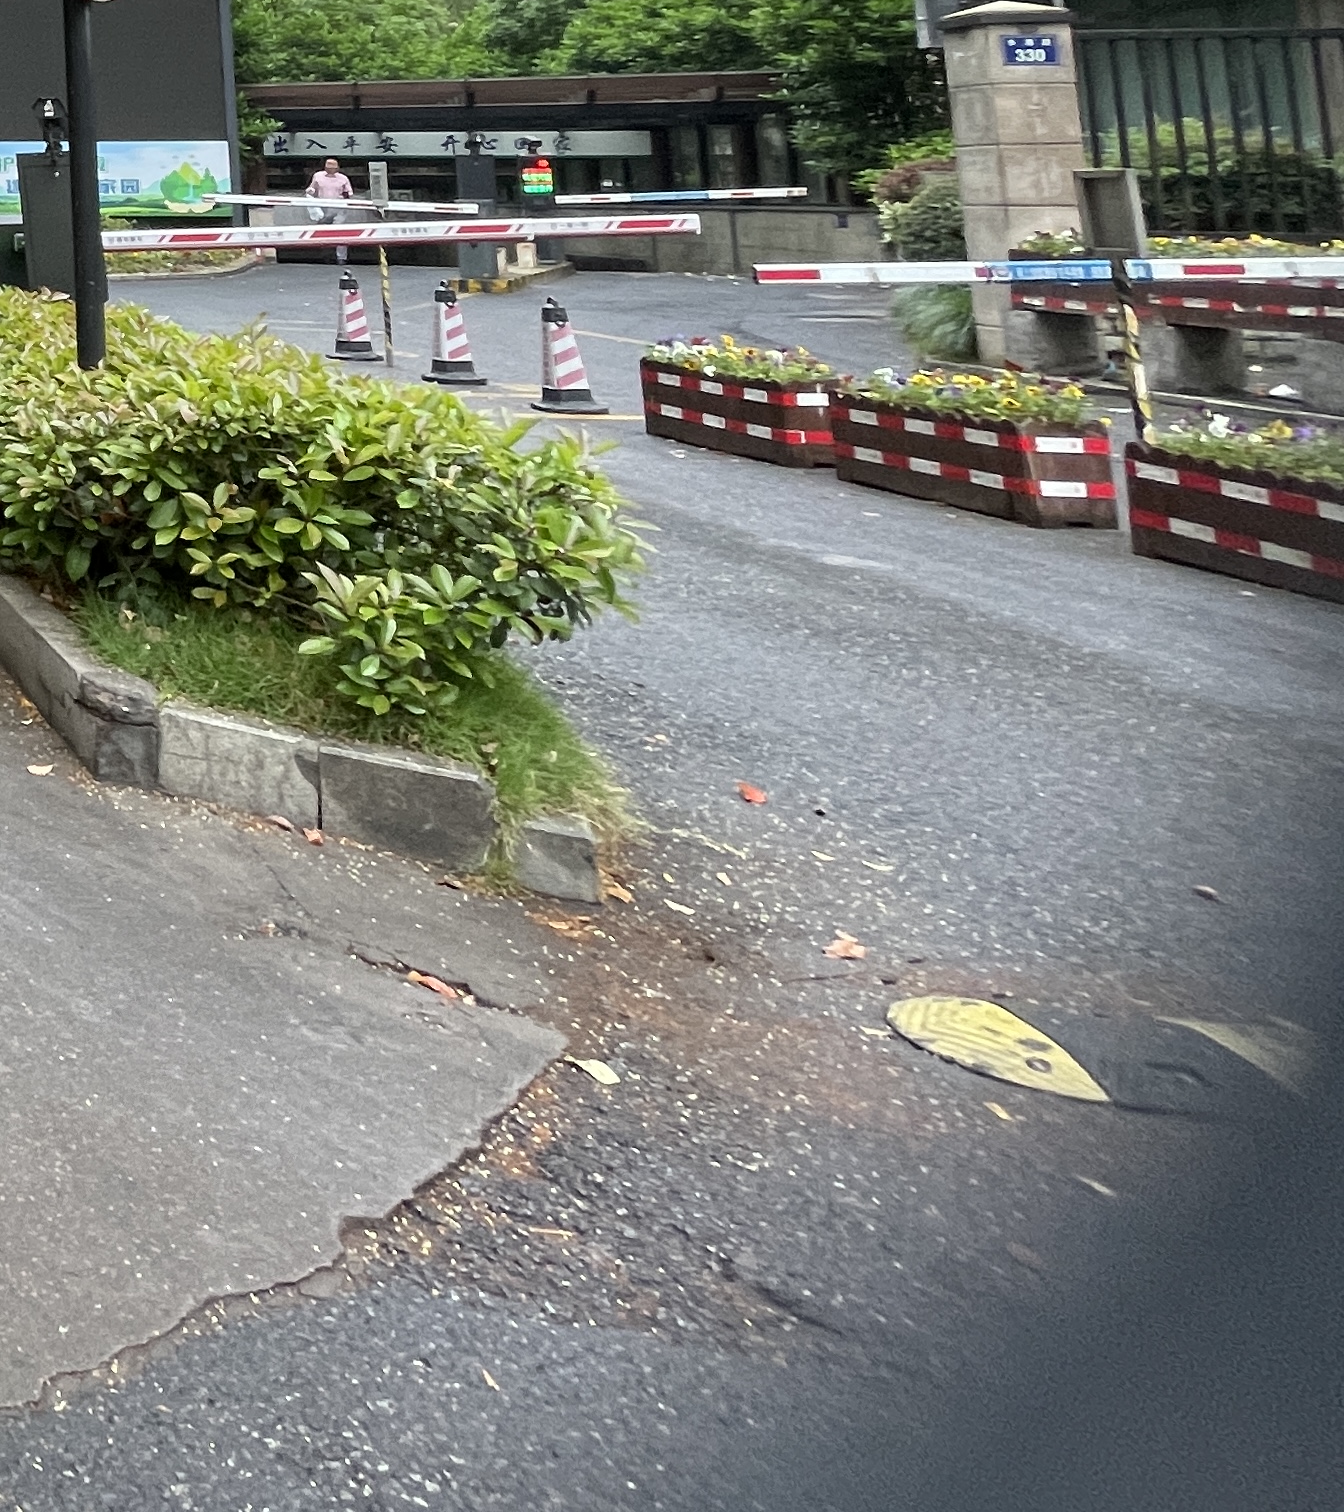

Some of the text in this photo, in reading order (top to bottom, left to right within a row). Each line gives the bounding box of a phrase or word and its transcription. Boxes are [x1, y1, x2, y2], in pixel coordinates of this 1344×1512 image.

[1014, 48, 1047, 62] 330
[273, 135, 399, 154] 出入平安
